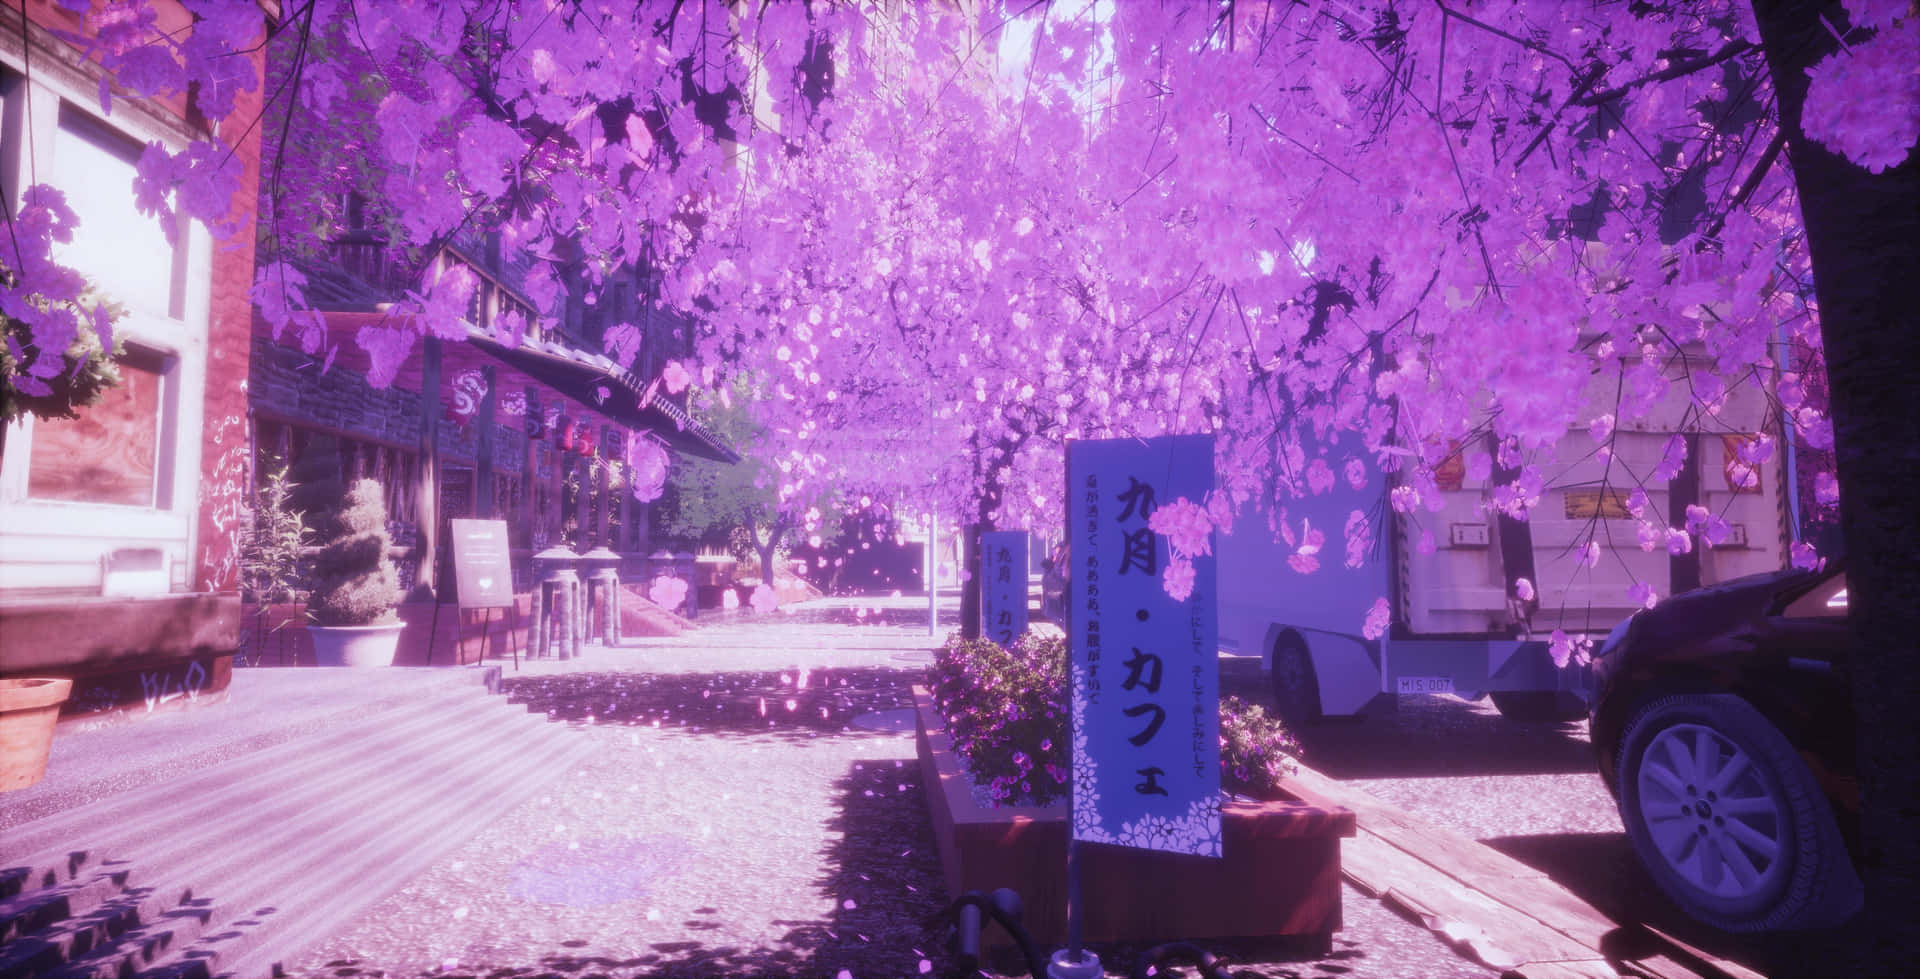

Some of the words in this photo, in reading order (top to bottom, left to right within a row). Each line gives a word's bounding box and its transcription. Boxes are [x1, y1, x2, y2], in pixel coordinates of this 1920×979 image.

[1116, 476, 1169, 797] 九月・カフェ
[1429, 679, 1450, 691] 007
